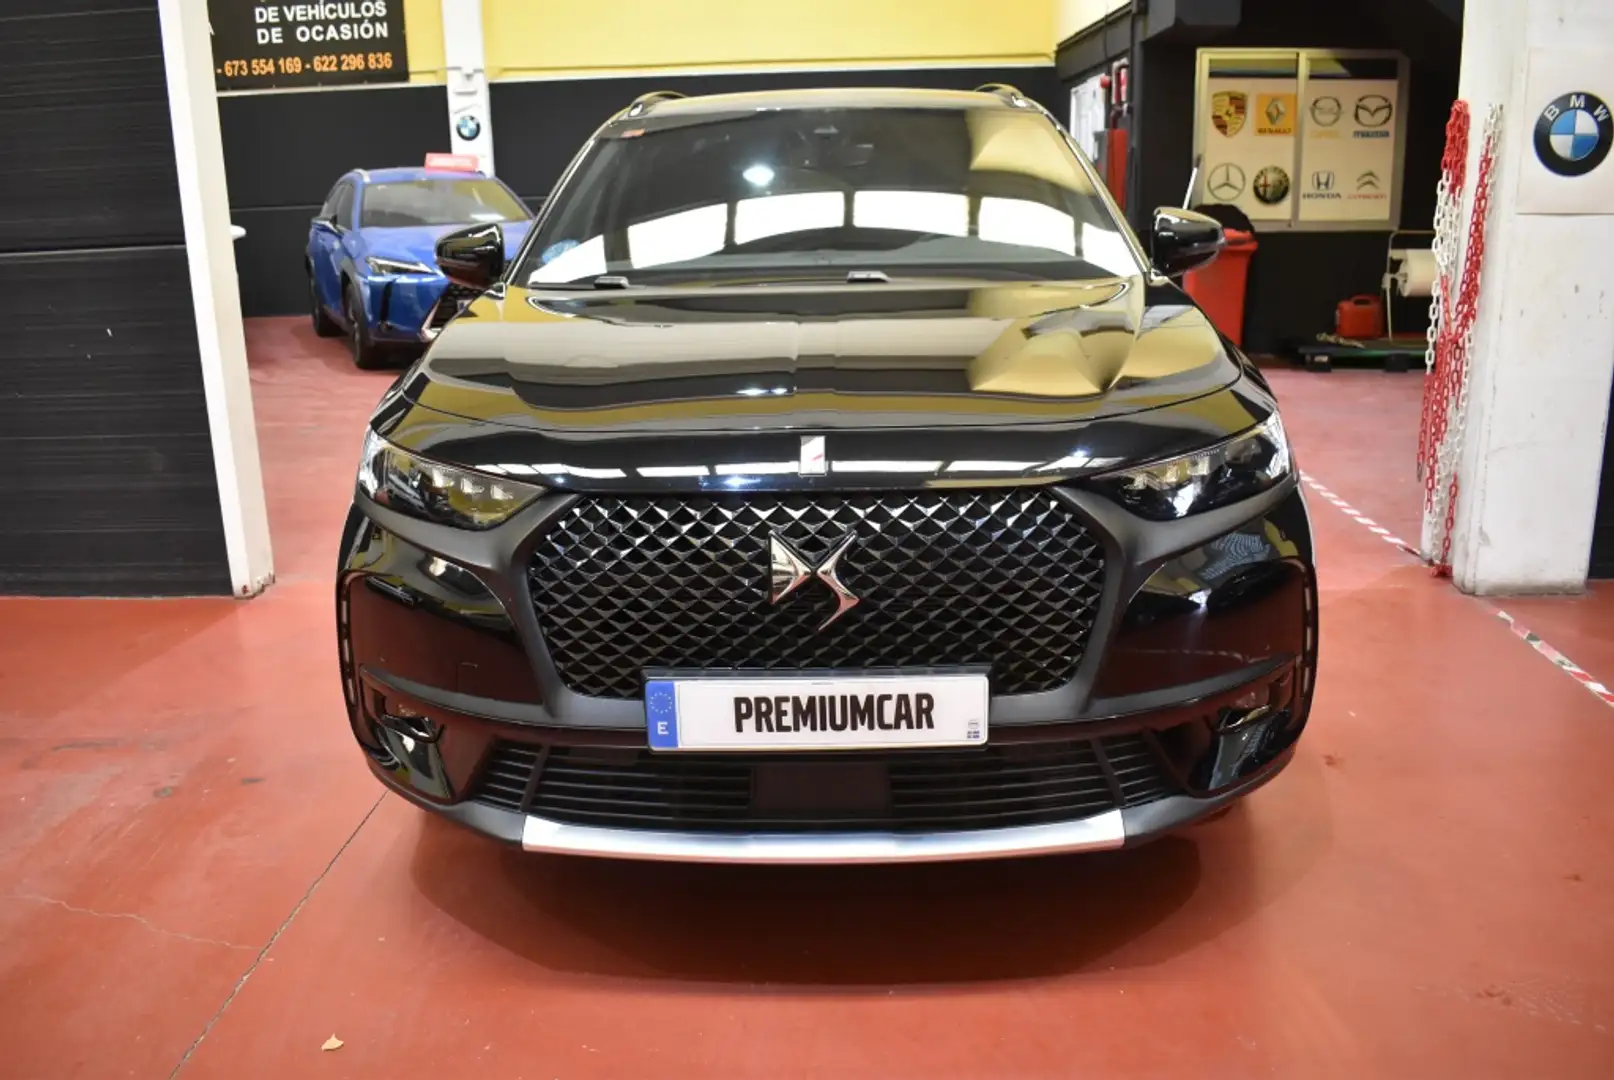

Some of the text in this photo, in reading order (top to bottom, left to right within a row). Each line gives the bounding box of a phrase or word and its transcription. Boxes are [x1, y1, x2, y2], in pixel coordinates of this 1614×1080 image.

[255, 0, 387, 23] DE VEHÍCULOS
[256, 19, 388, 44] DE OCASIÓN
[224, 60, 248, 77] 673
[251, 58, 275, 75] 554
[278, 56, 301, 73] 169
[313, 54, 338, 72] 622
[340, 53, 365, 71] 296
[367, 51, 393, 69] 836
[1544, 95, 1609, 122] BMW
[1302, 192, 1341, 200] HONDA
[733, 693, 935, 733] PREMIUMCAR
[657, 721, 669, 736] E
